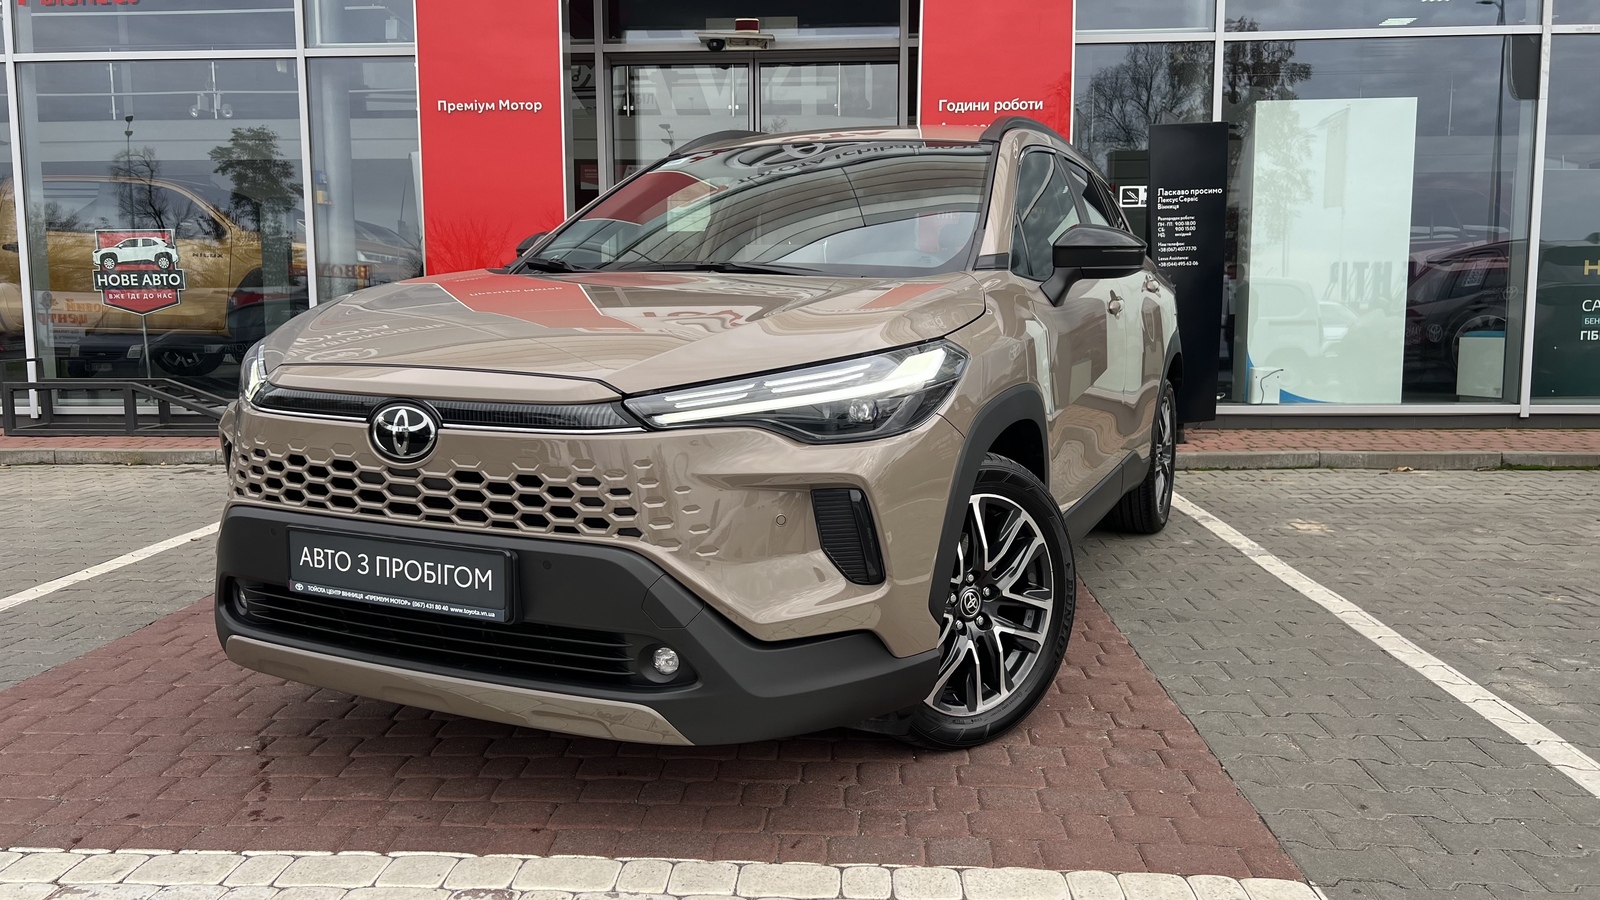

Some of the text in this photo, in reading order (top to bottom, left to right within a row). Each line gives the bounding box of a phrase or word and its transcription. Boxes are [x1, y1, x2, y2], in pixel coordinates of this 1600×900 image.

[437, 99, 543, 114] Преміум Мотор
[938, 98, 1044, 114] Години роботи
[1157, 188, 1223, 196] Ласкаво просимо
[97, 273, 180, 287] НОВЕ АВТО
[127, 292, 141, 300] ЇДЕ
[299, 546, 352, 573] АВТО
[375, 555, 493, 591] ПРОБІГОМ
[306, 584, 326, 594] ТОЙОТА
[326, 588, 342, 596] ЦЕНТР
[341, 590, 364, 600] ВІННИЦЯ
[412, 600, 426, 609] (067)
[449, 606, 496, 618] www.toyota.vn.ua
